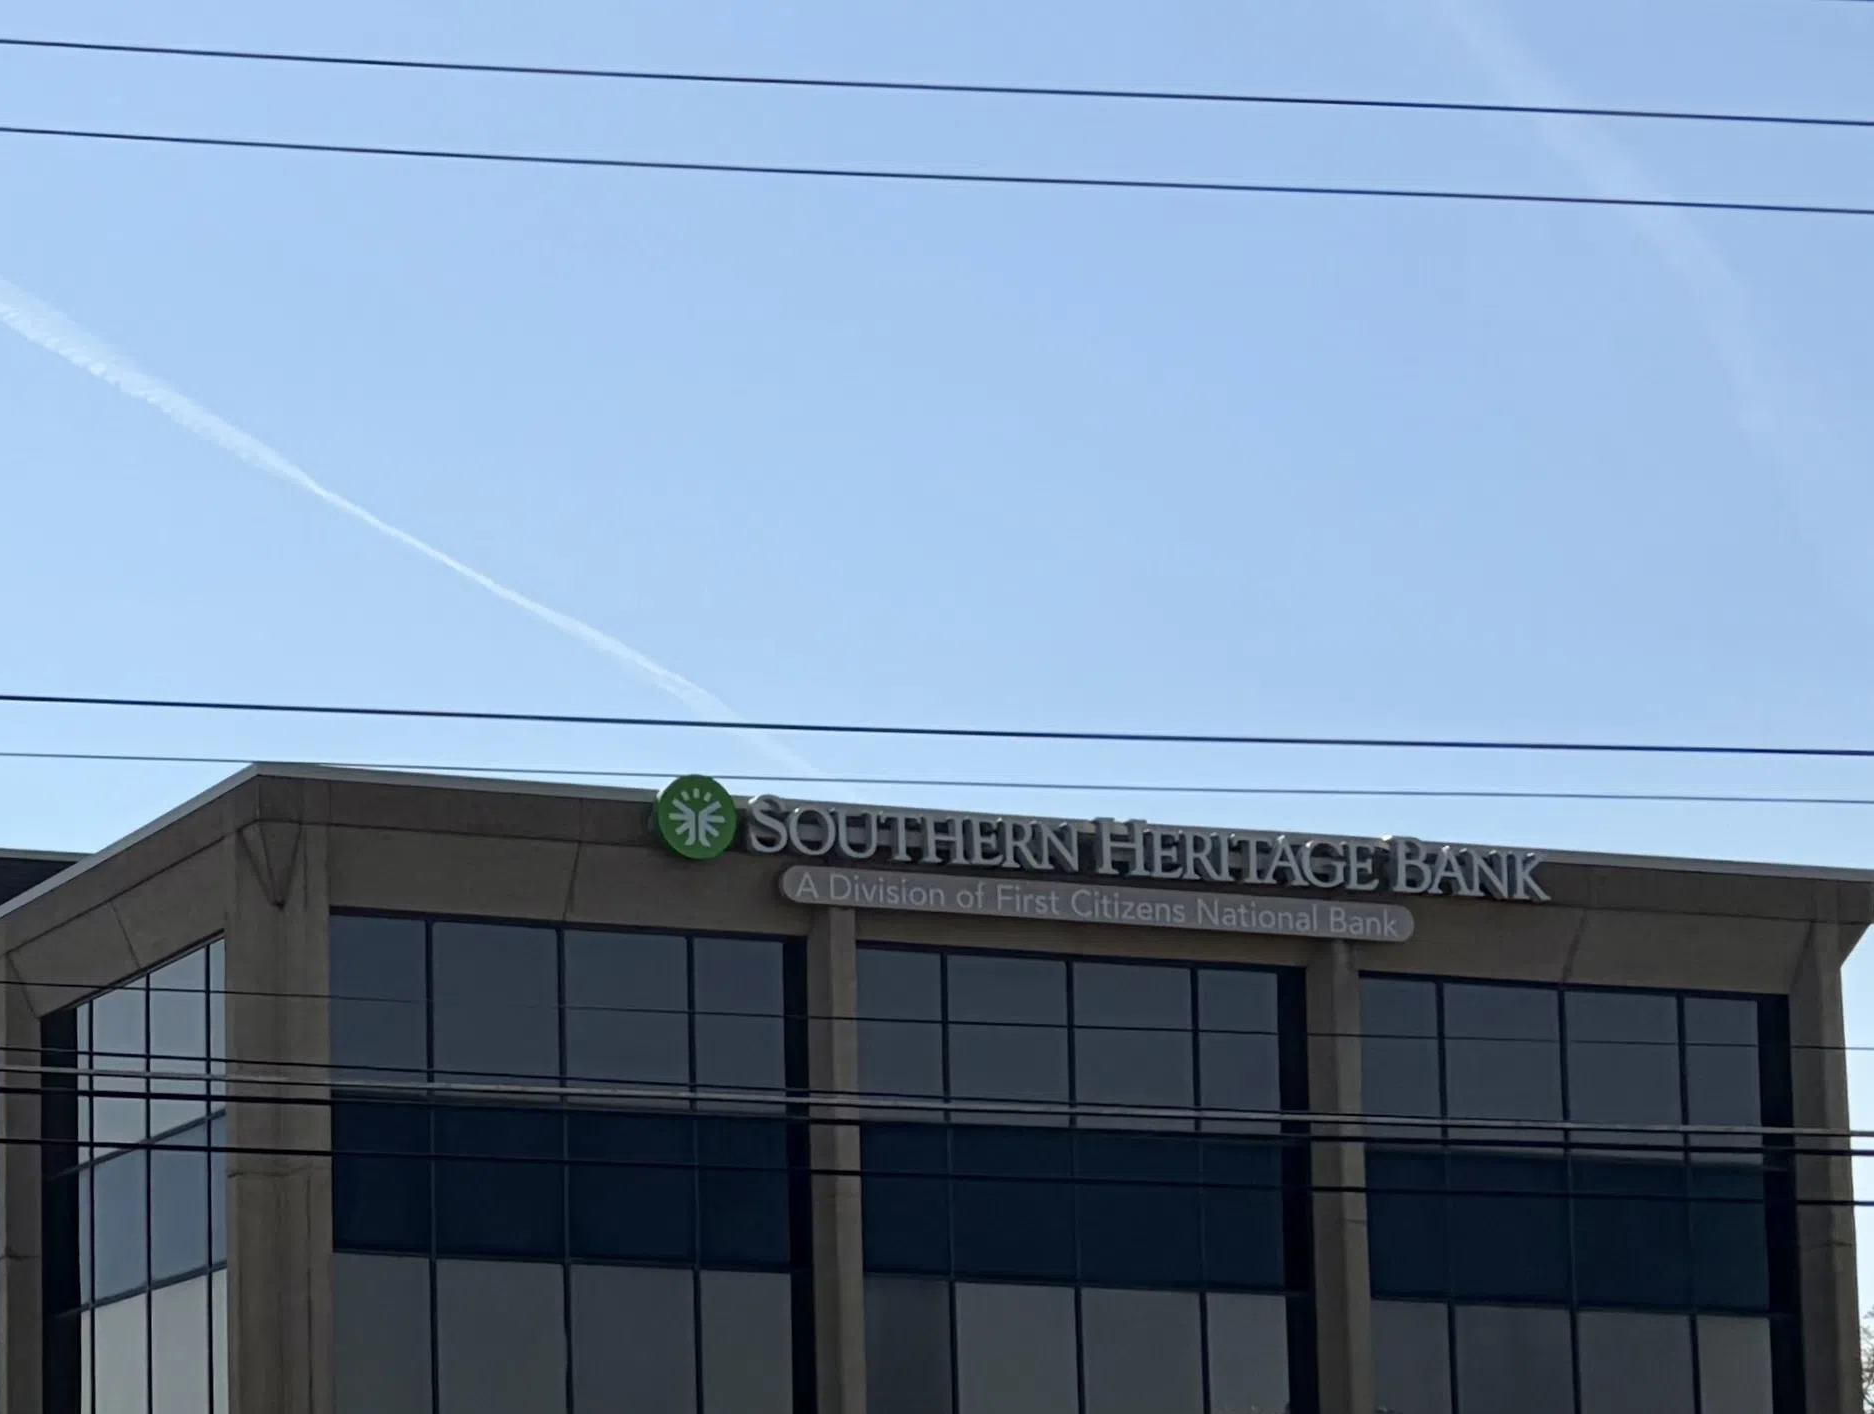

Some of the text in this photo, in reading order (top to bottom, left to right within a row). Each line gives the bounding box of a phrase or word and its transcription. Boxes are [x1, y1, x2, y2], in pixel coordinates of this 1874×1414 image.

[747, 793, 1553, 902] SOUTHERN HERITAGE BANK
[796, 872, 1400, 938] A Division of First Citizens National Bank
